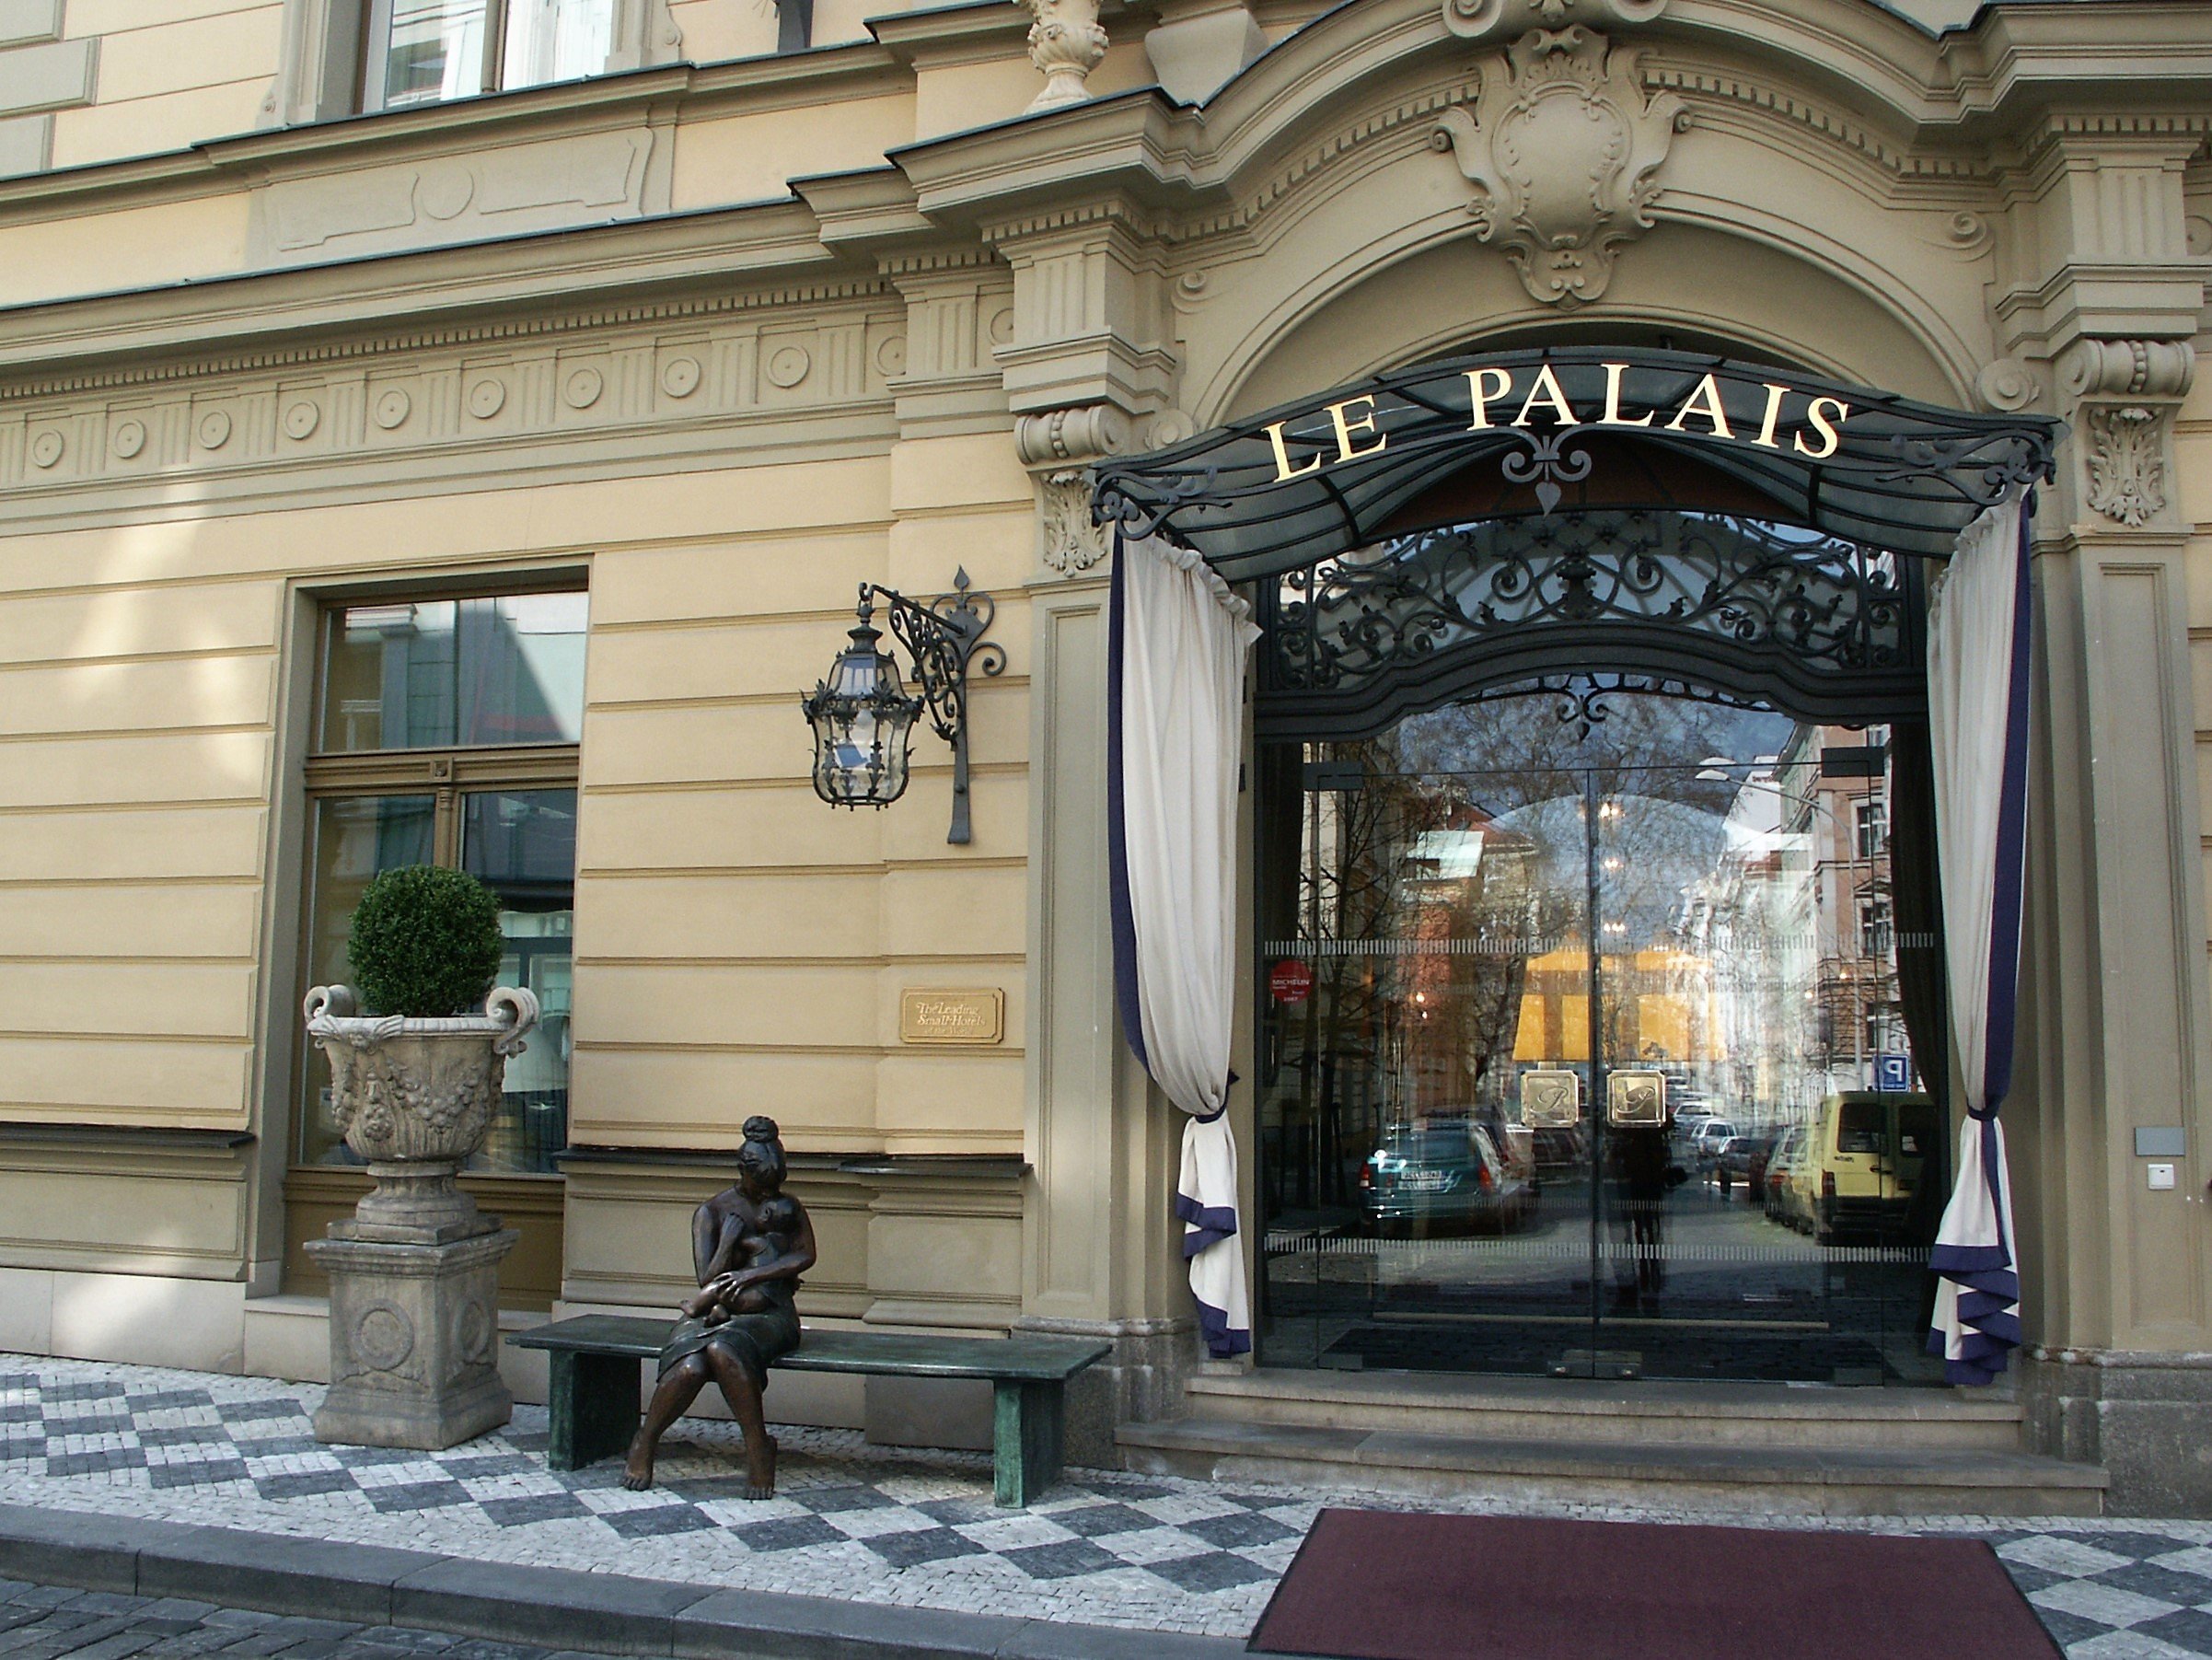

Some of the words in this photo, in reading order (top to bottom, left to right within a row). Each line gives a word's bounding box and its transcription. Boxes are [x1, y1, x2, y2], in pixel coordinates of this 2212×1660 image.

[1260, 393, 1387, 483] LE
[1462, 364, 1852, 459] PALAIS
[916, 1002, 936, 1015] The
[935, 1002, 979, 1016] Leading
[917, 1014, 948, 1026] Small
[948, 1015, 986, 1027] Hotels
